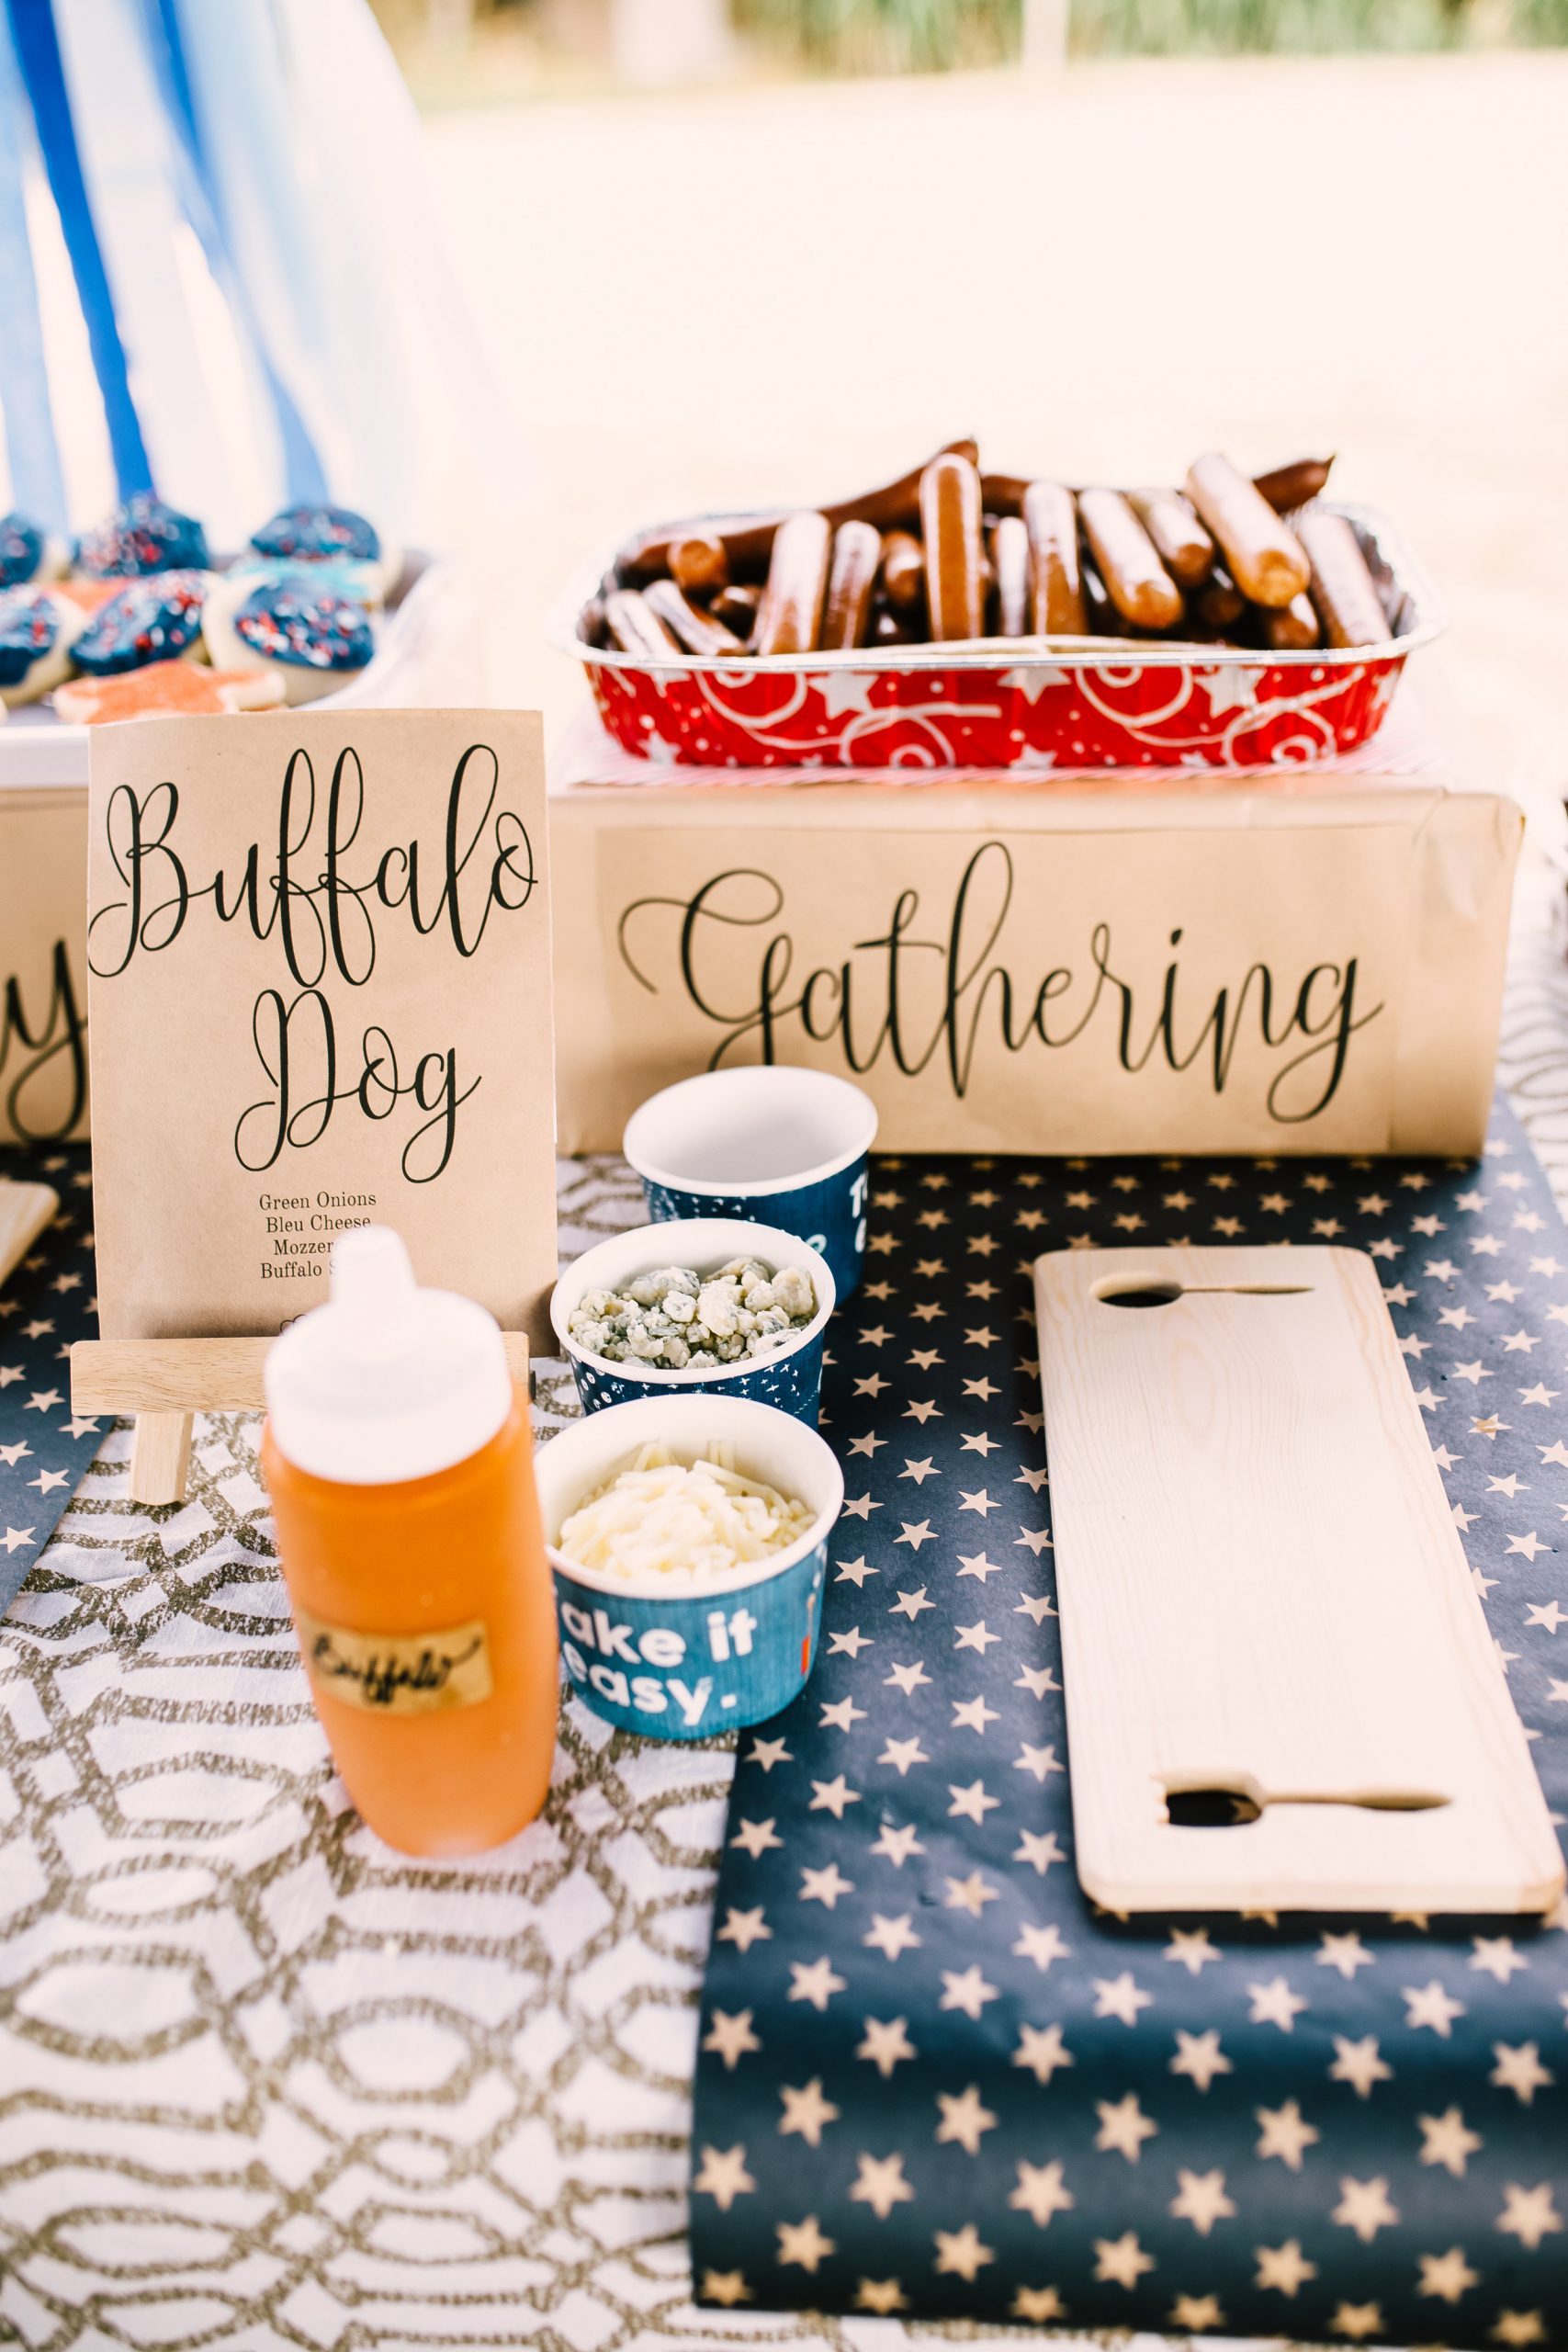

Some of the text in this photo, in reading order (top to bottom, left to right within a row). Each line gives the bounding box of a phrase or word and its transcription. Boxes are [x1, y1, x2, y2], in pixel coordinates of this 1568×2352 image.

[88, 744, 538, 988] Buffalo
[617, 841, 1384, 1123] Gathering
[235, 989, 482, 1183] Dog
[259, 1191, 377, 1211] Green Onions
[265, 1214, 371, 1233] Bleu Cheese
[260, 1261, 322, 1279] Buffalo
[274, 1238, 338, 1256] Mozzer
[559, 1601, 758, 1668] ake it
[562, 1641, 737, 1727] easy.
